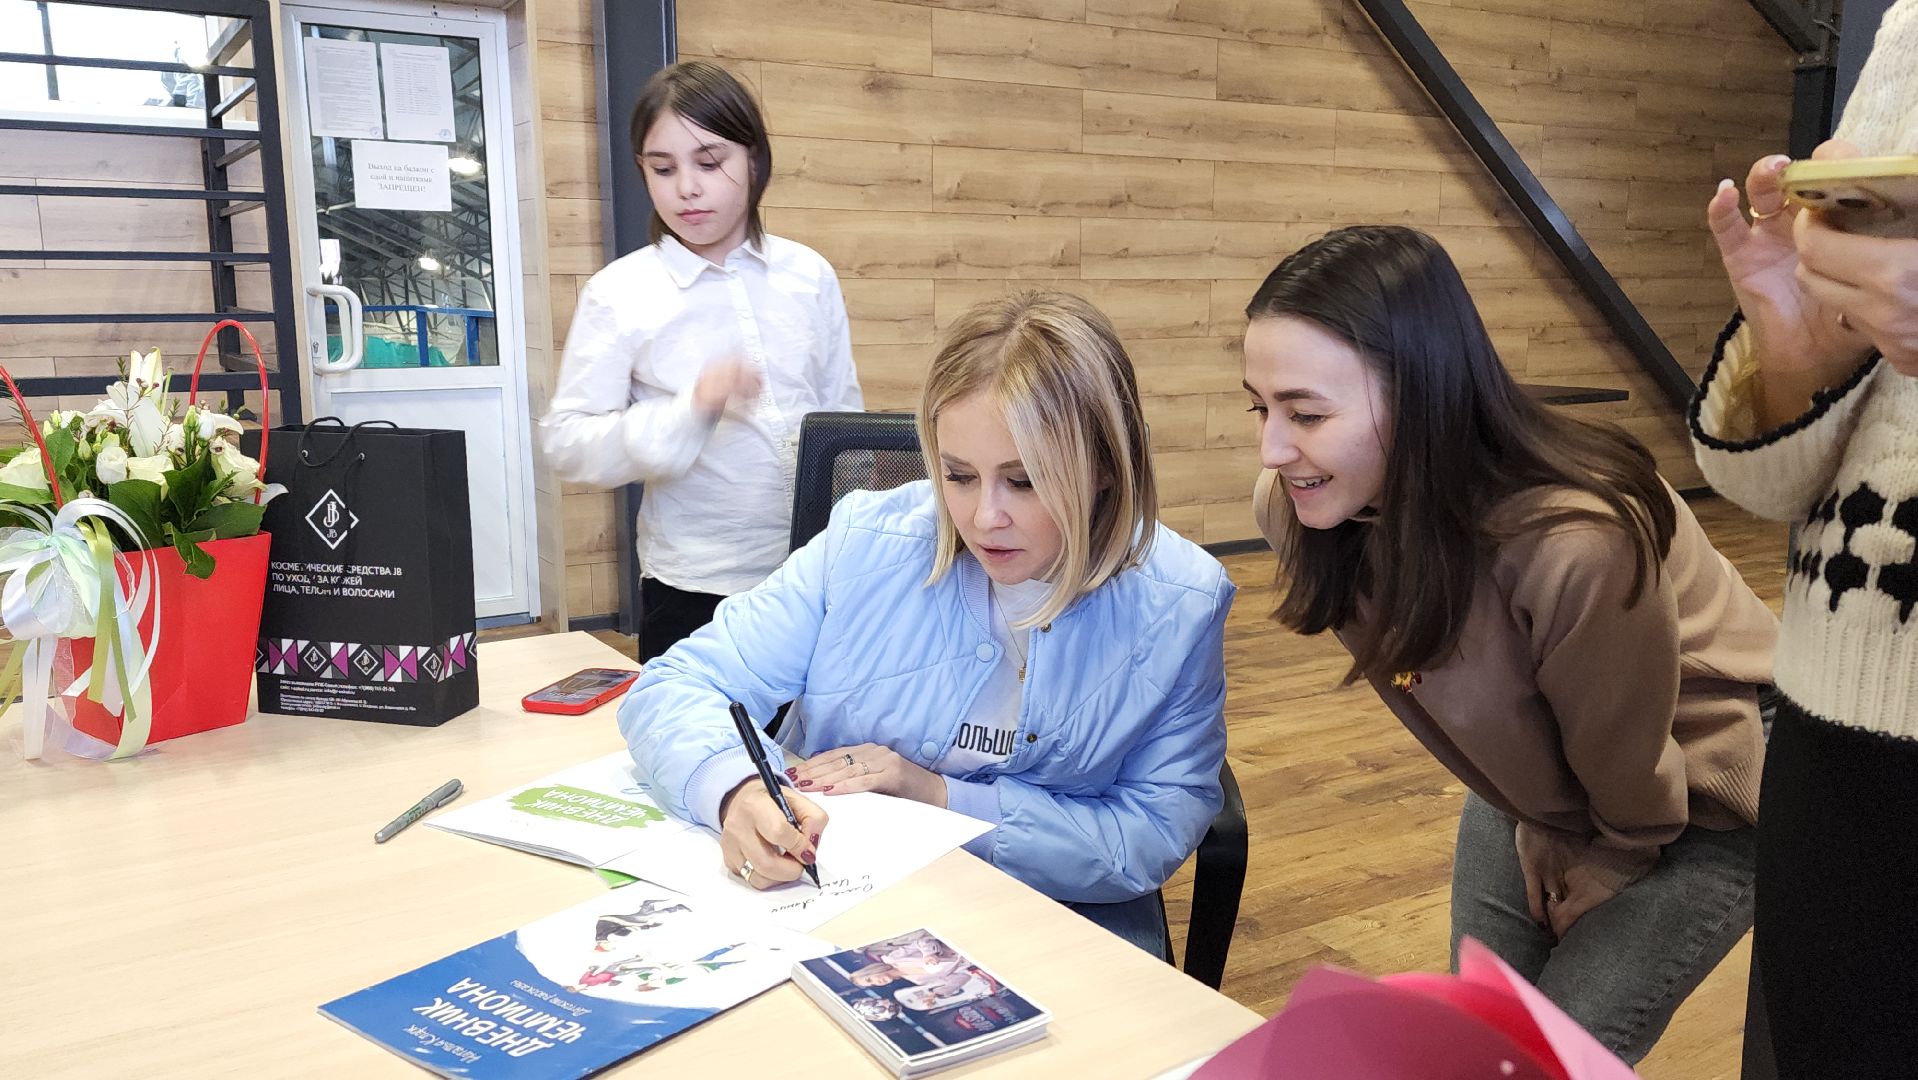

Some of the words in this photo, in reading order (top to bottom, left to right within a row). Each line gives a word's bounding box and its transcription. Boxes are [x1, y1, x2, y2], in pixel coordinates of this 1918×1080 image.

[271, 561, 344, 574] КОСМЕИЧЕСКИЕ
[272, 573, 285, 582] ПО
[286, 574, 317, 584] УХОД
[317, 575, 329, 584] ЗА
[333, 588, 341, 596] И
[342, 588, 396, 599] ВОЛОСАМИ
[952, 722, 1017, 756] ОЛЬШ
[524, 799, 630, 824] ДНЕВНИК
[543, 789, 647, 818] ЧЕМПИОНА
[446, 977, 587, 1044] ЧЕМПИОНА
[412, 997, 555, 1057] ДНЕВНИК
[434, 1040, 482, 1064] Наталья
